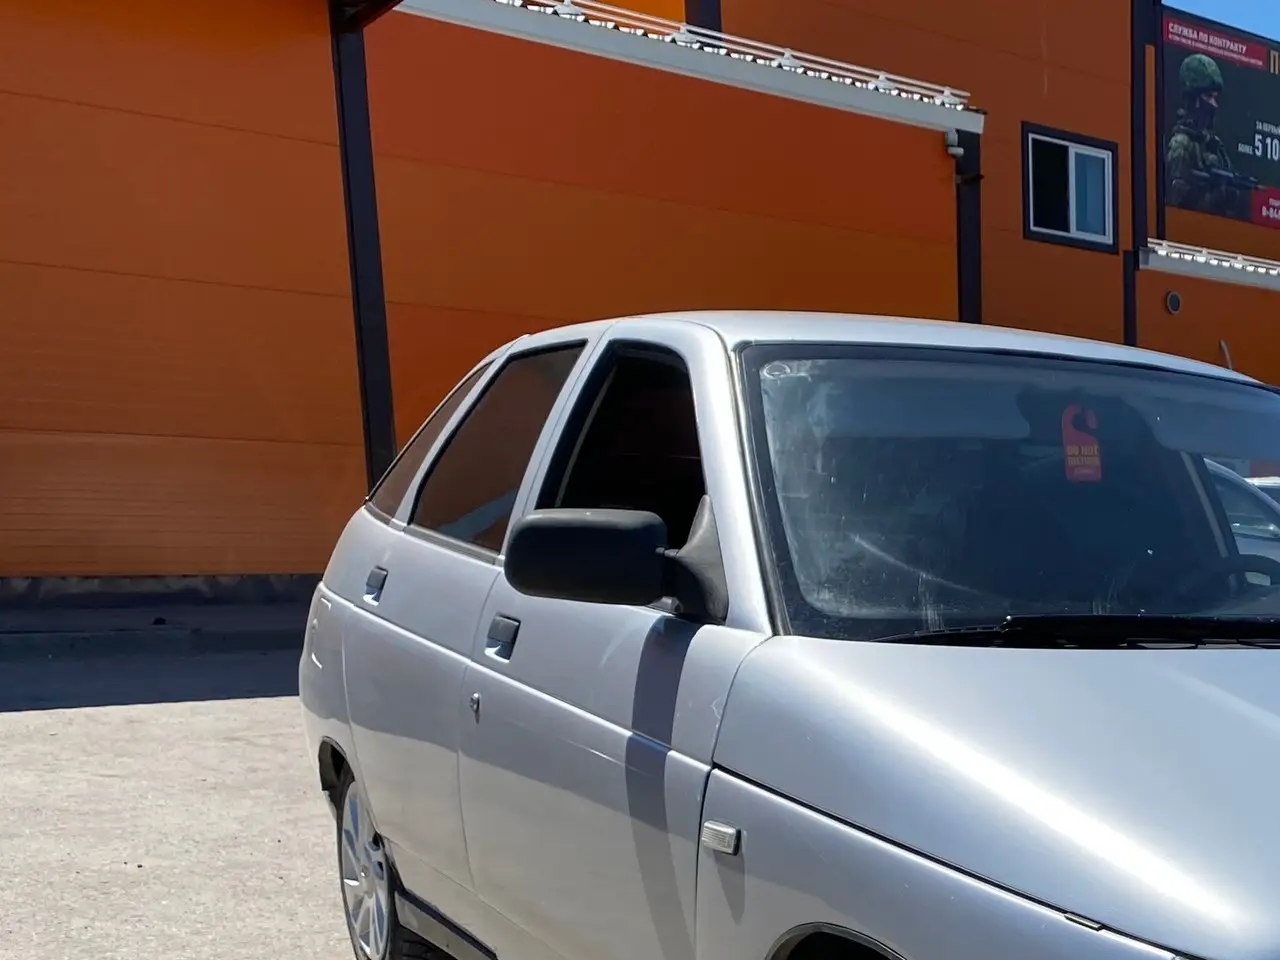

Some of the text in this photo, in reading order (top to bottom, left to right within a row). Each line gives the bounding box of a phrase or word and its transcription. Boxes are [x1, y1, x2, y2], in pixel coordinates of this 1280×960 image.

[1168, 22, 1198, 40] СЛУЖБА
[1198, 31, 1208, 43] ПО
[1209, 34, 1247, 54] КОНТРАКТУ
[1254, 133, 1262, 157] 5
